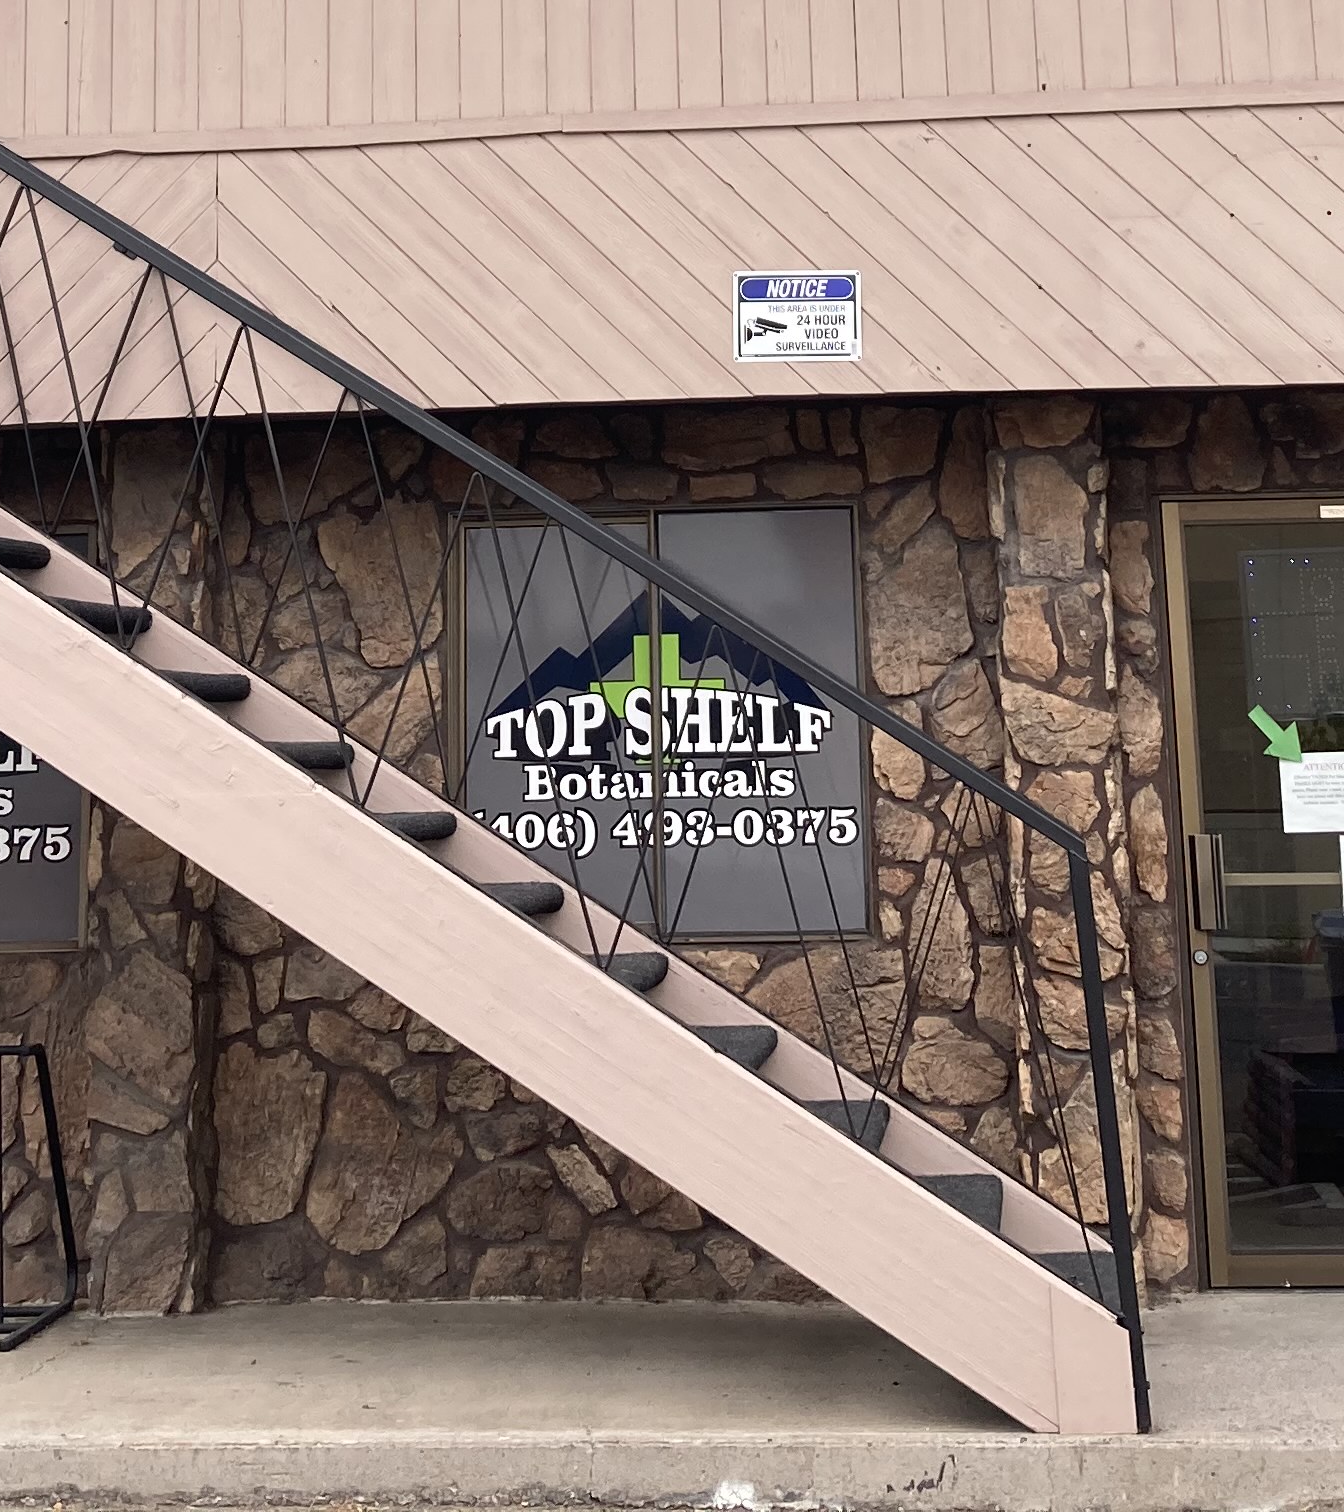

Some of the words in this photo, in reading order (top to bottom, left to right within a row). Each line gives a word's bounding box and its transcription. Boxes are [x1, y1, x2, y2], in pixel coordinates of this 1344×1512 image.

[766, 279, 828, 298] NOTICE
[768, 305, 785, 313] THIS
[787, 304, 807, 313] AREA
[809, 304, 817, 312] IS
[819, 304, 846, 312] UNDER
[796, 314, 810, 326] 24
[814, 314, 846, 325] HOUR
[804, 328, 839, 339] VIDEO
[775, 341, 846, 352] SURVEILLANCE
[485, 692, 607, 759] TOP
[624, 686, 834, 758] SHELF
[522, 760, 795, 802] Botanicals
[472, 808, 598, 859] 406)
[610, 806, 858, 848] 493-0375
